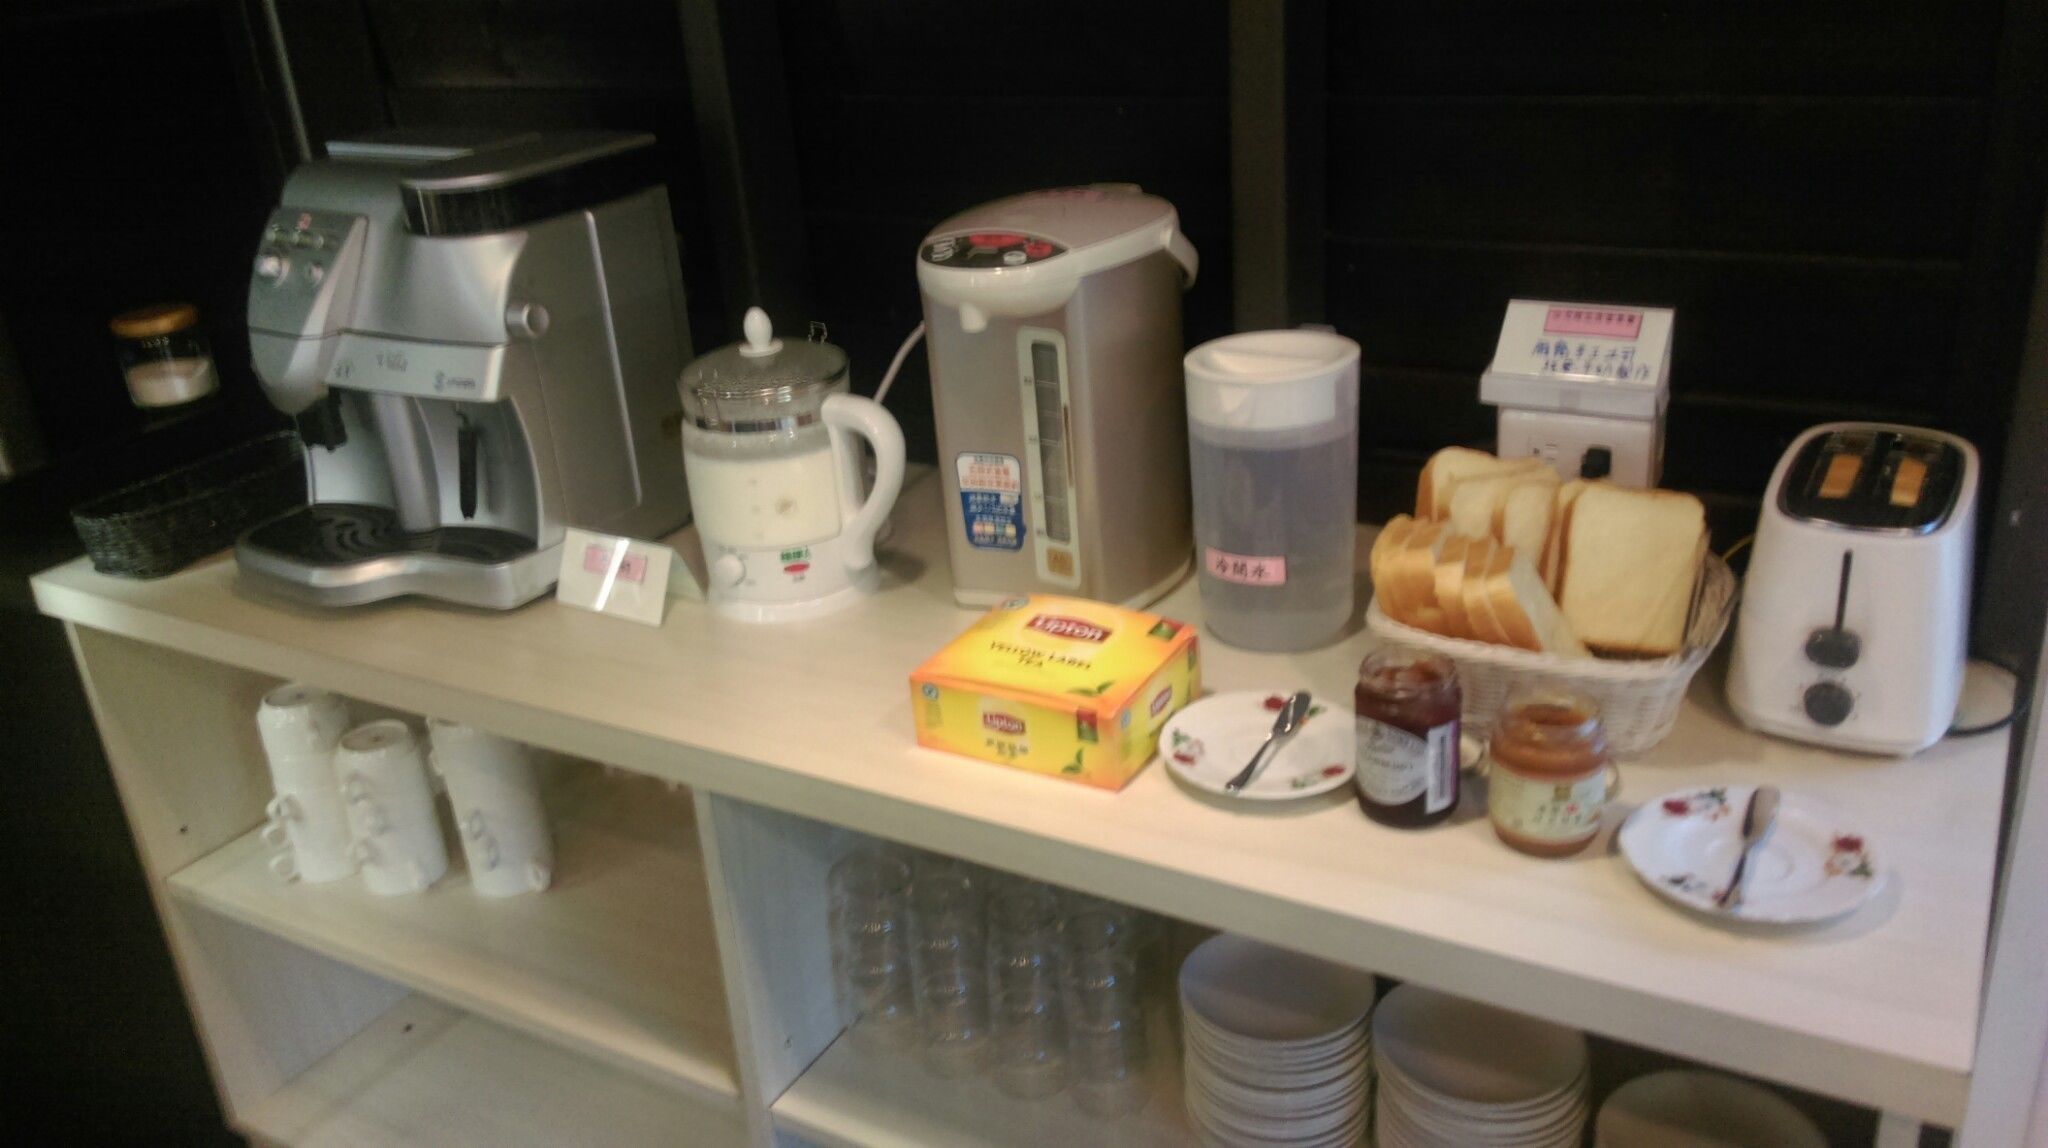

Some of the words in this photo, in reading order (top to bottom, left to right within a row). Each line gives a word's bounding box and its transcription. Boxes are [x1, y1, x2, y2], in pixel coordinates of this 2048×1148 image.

[1216, 555, 1268, 578] 冷開水
[1033, 615, 1104, 641] Lipton
[990, 641, 1046, 657] YELLOW
[1048, 651, 1092, 670] LABEL
[1018, 656, 1043, 668] TEA
[986, 713, 1023, 733] Lipton
